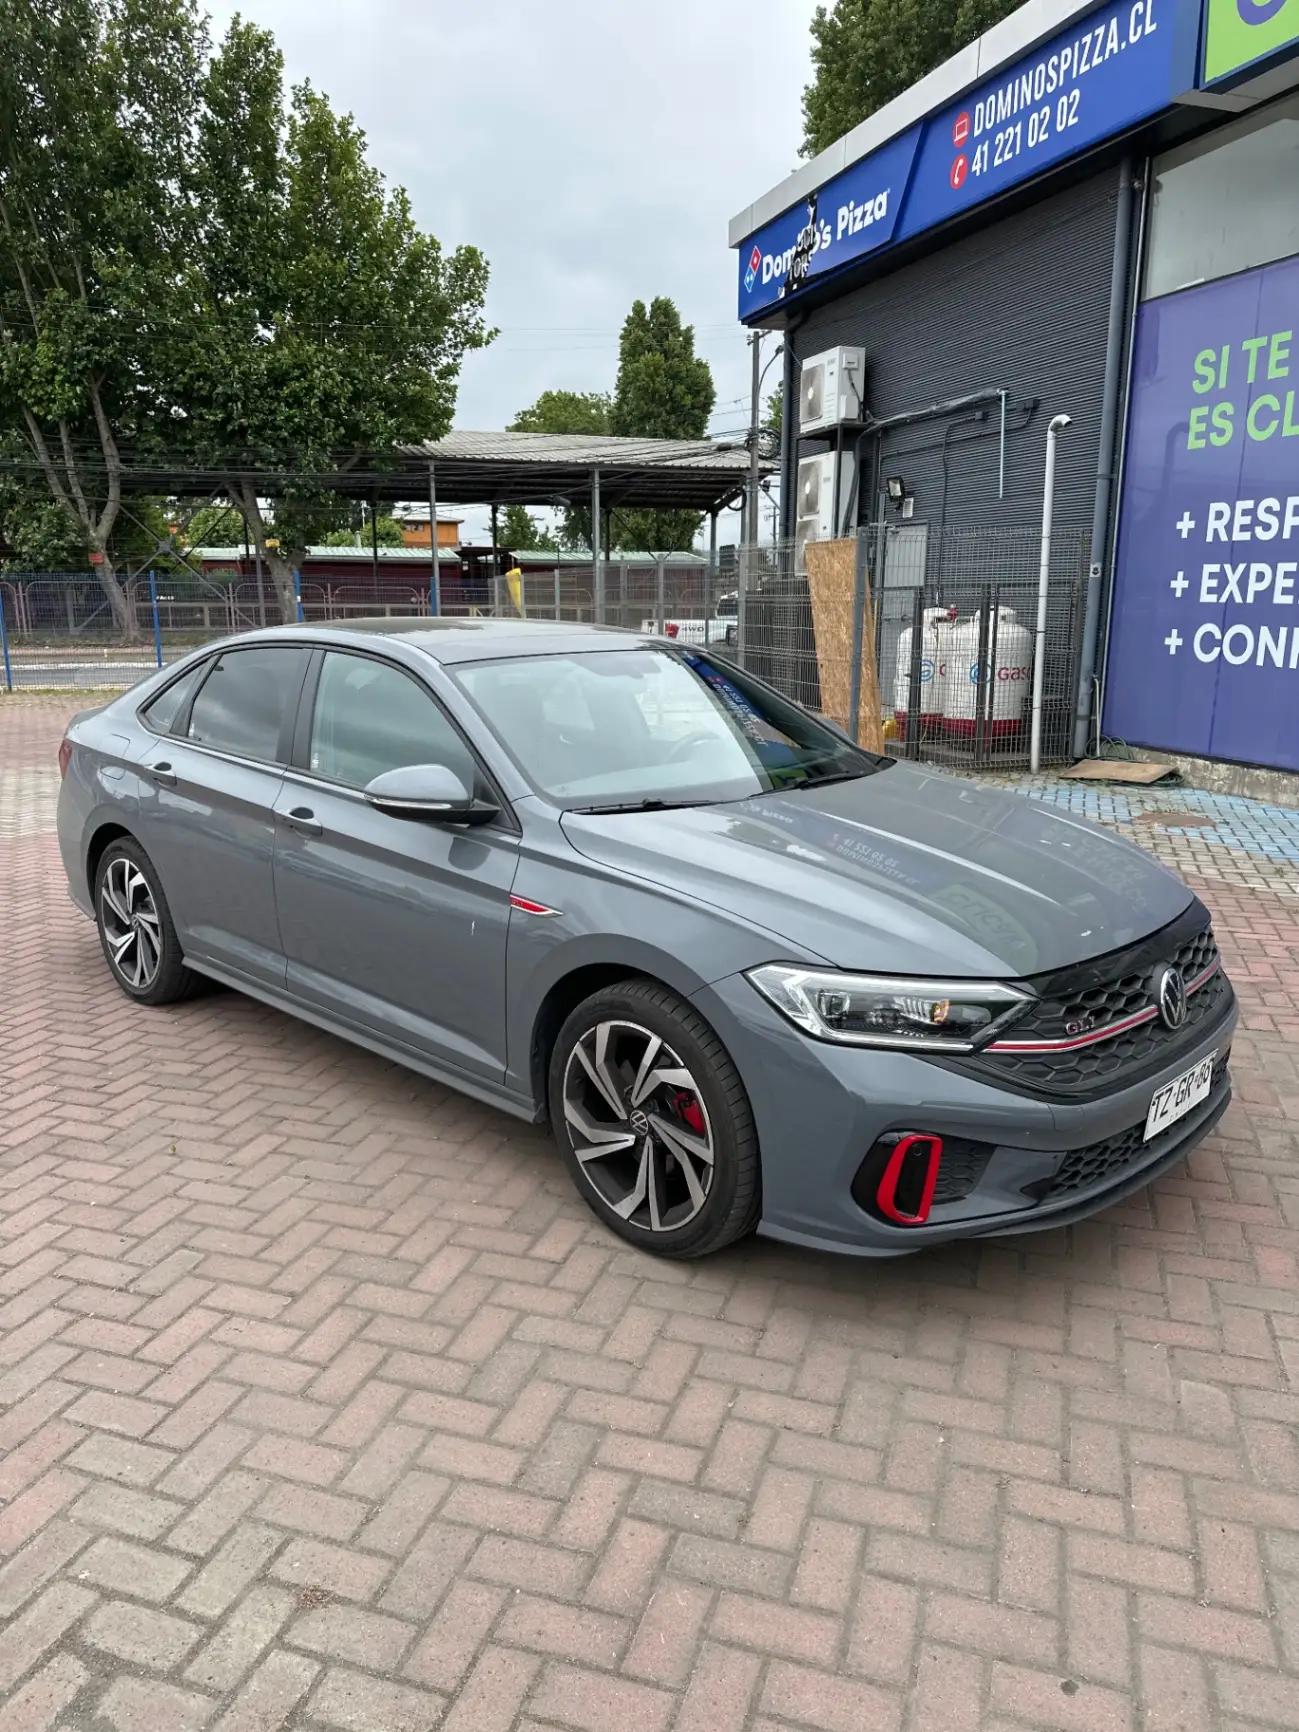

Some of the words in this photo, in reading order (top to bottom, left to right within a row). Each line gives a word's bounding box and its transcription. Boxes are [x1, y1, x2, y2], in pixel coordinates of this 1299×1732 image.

[973, 0, 1158, 138] DOMINOSPIZZA.CL
[971, 140, 989, 177] 41
[993, 121, 1023, 167] 221
[1027, 105, 1050, 148] 02
[1055, 88, 1081, 133] 02
[762, 219, 832, 285] Domo's
[836, 190, 888, 241] Pizza
[1192, 344, 1231, 394] SI
[1241, 330, 1293, 384] TE
[1187, 401, 1235, 450] ES
[1246, 390, 1299, 442] CL
